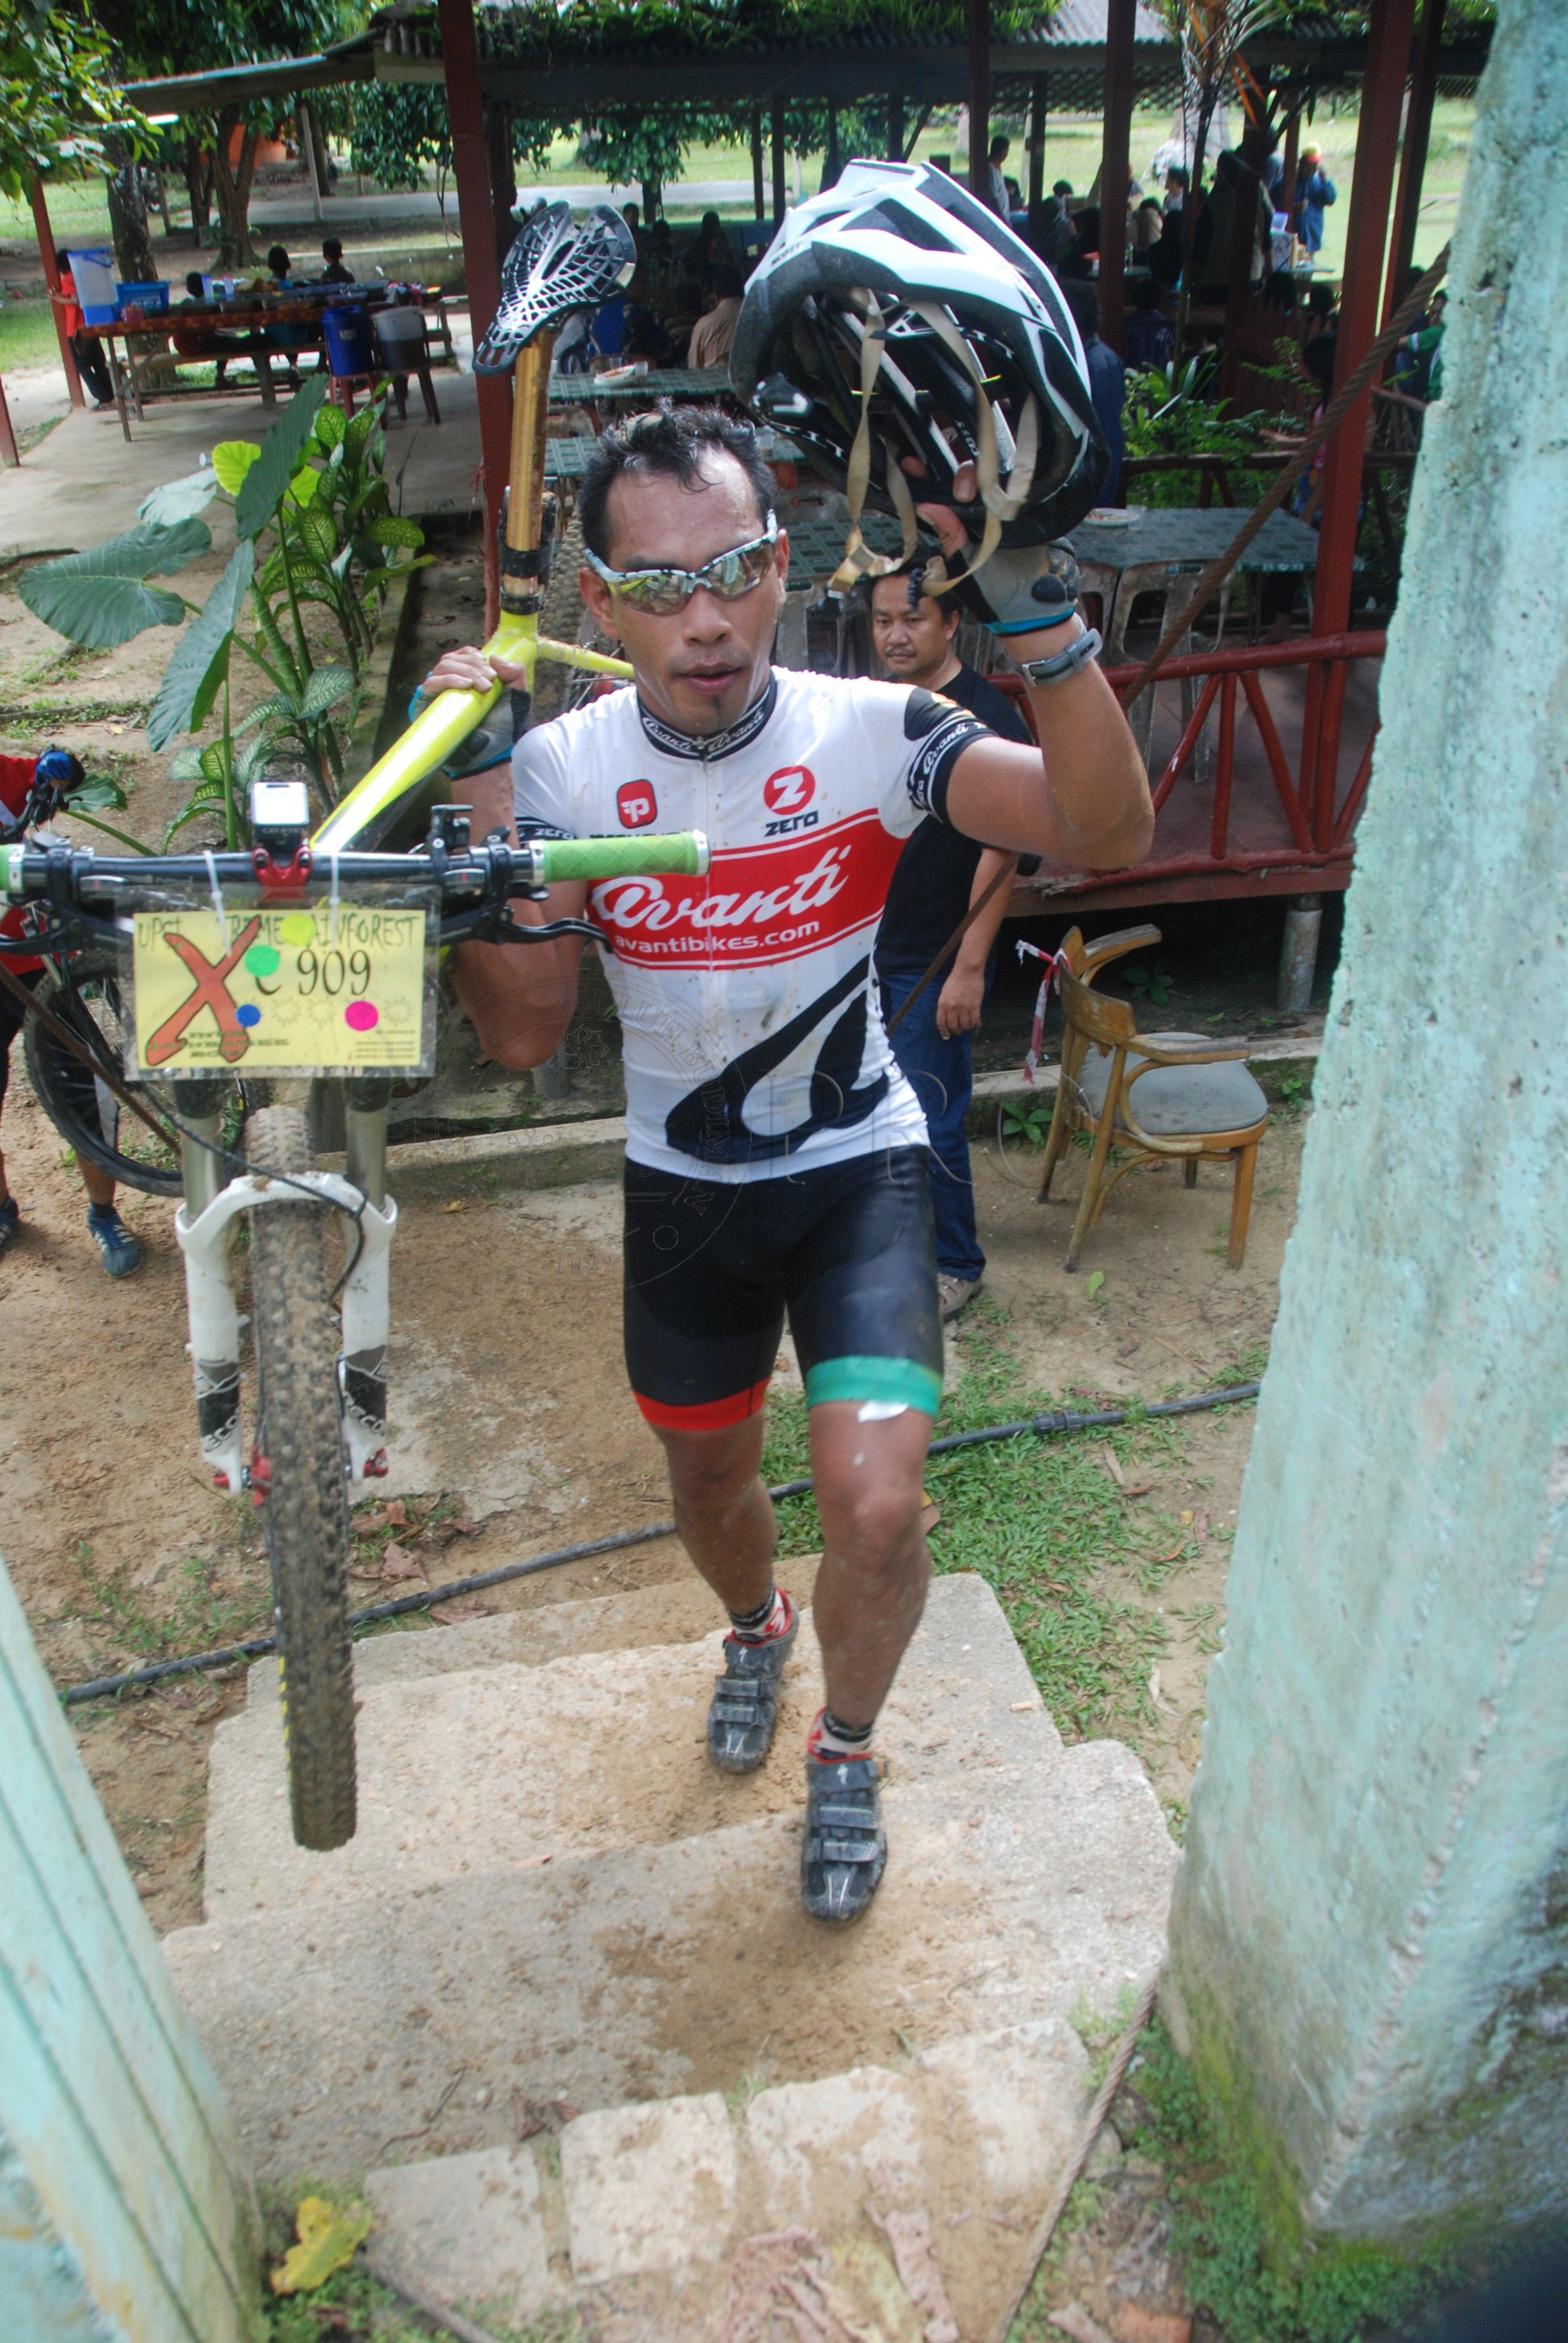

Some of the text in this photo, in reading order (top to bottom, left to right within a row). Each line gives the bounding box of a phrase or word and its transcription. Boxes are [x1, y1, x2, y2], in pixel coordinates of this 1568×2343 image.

[923, 722, 970, 775] Avanti
[590, 845, 852, 931] Avanti
[615, 921, 819, 954] avantibikes.com
[297, 949, 371, 996] 909
